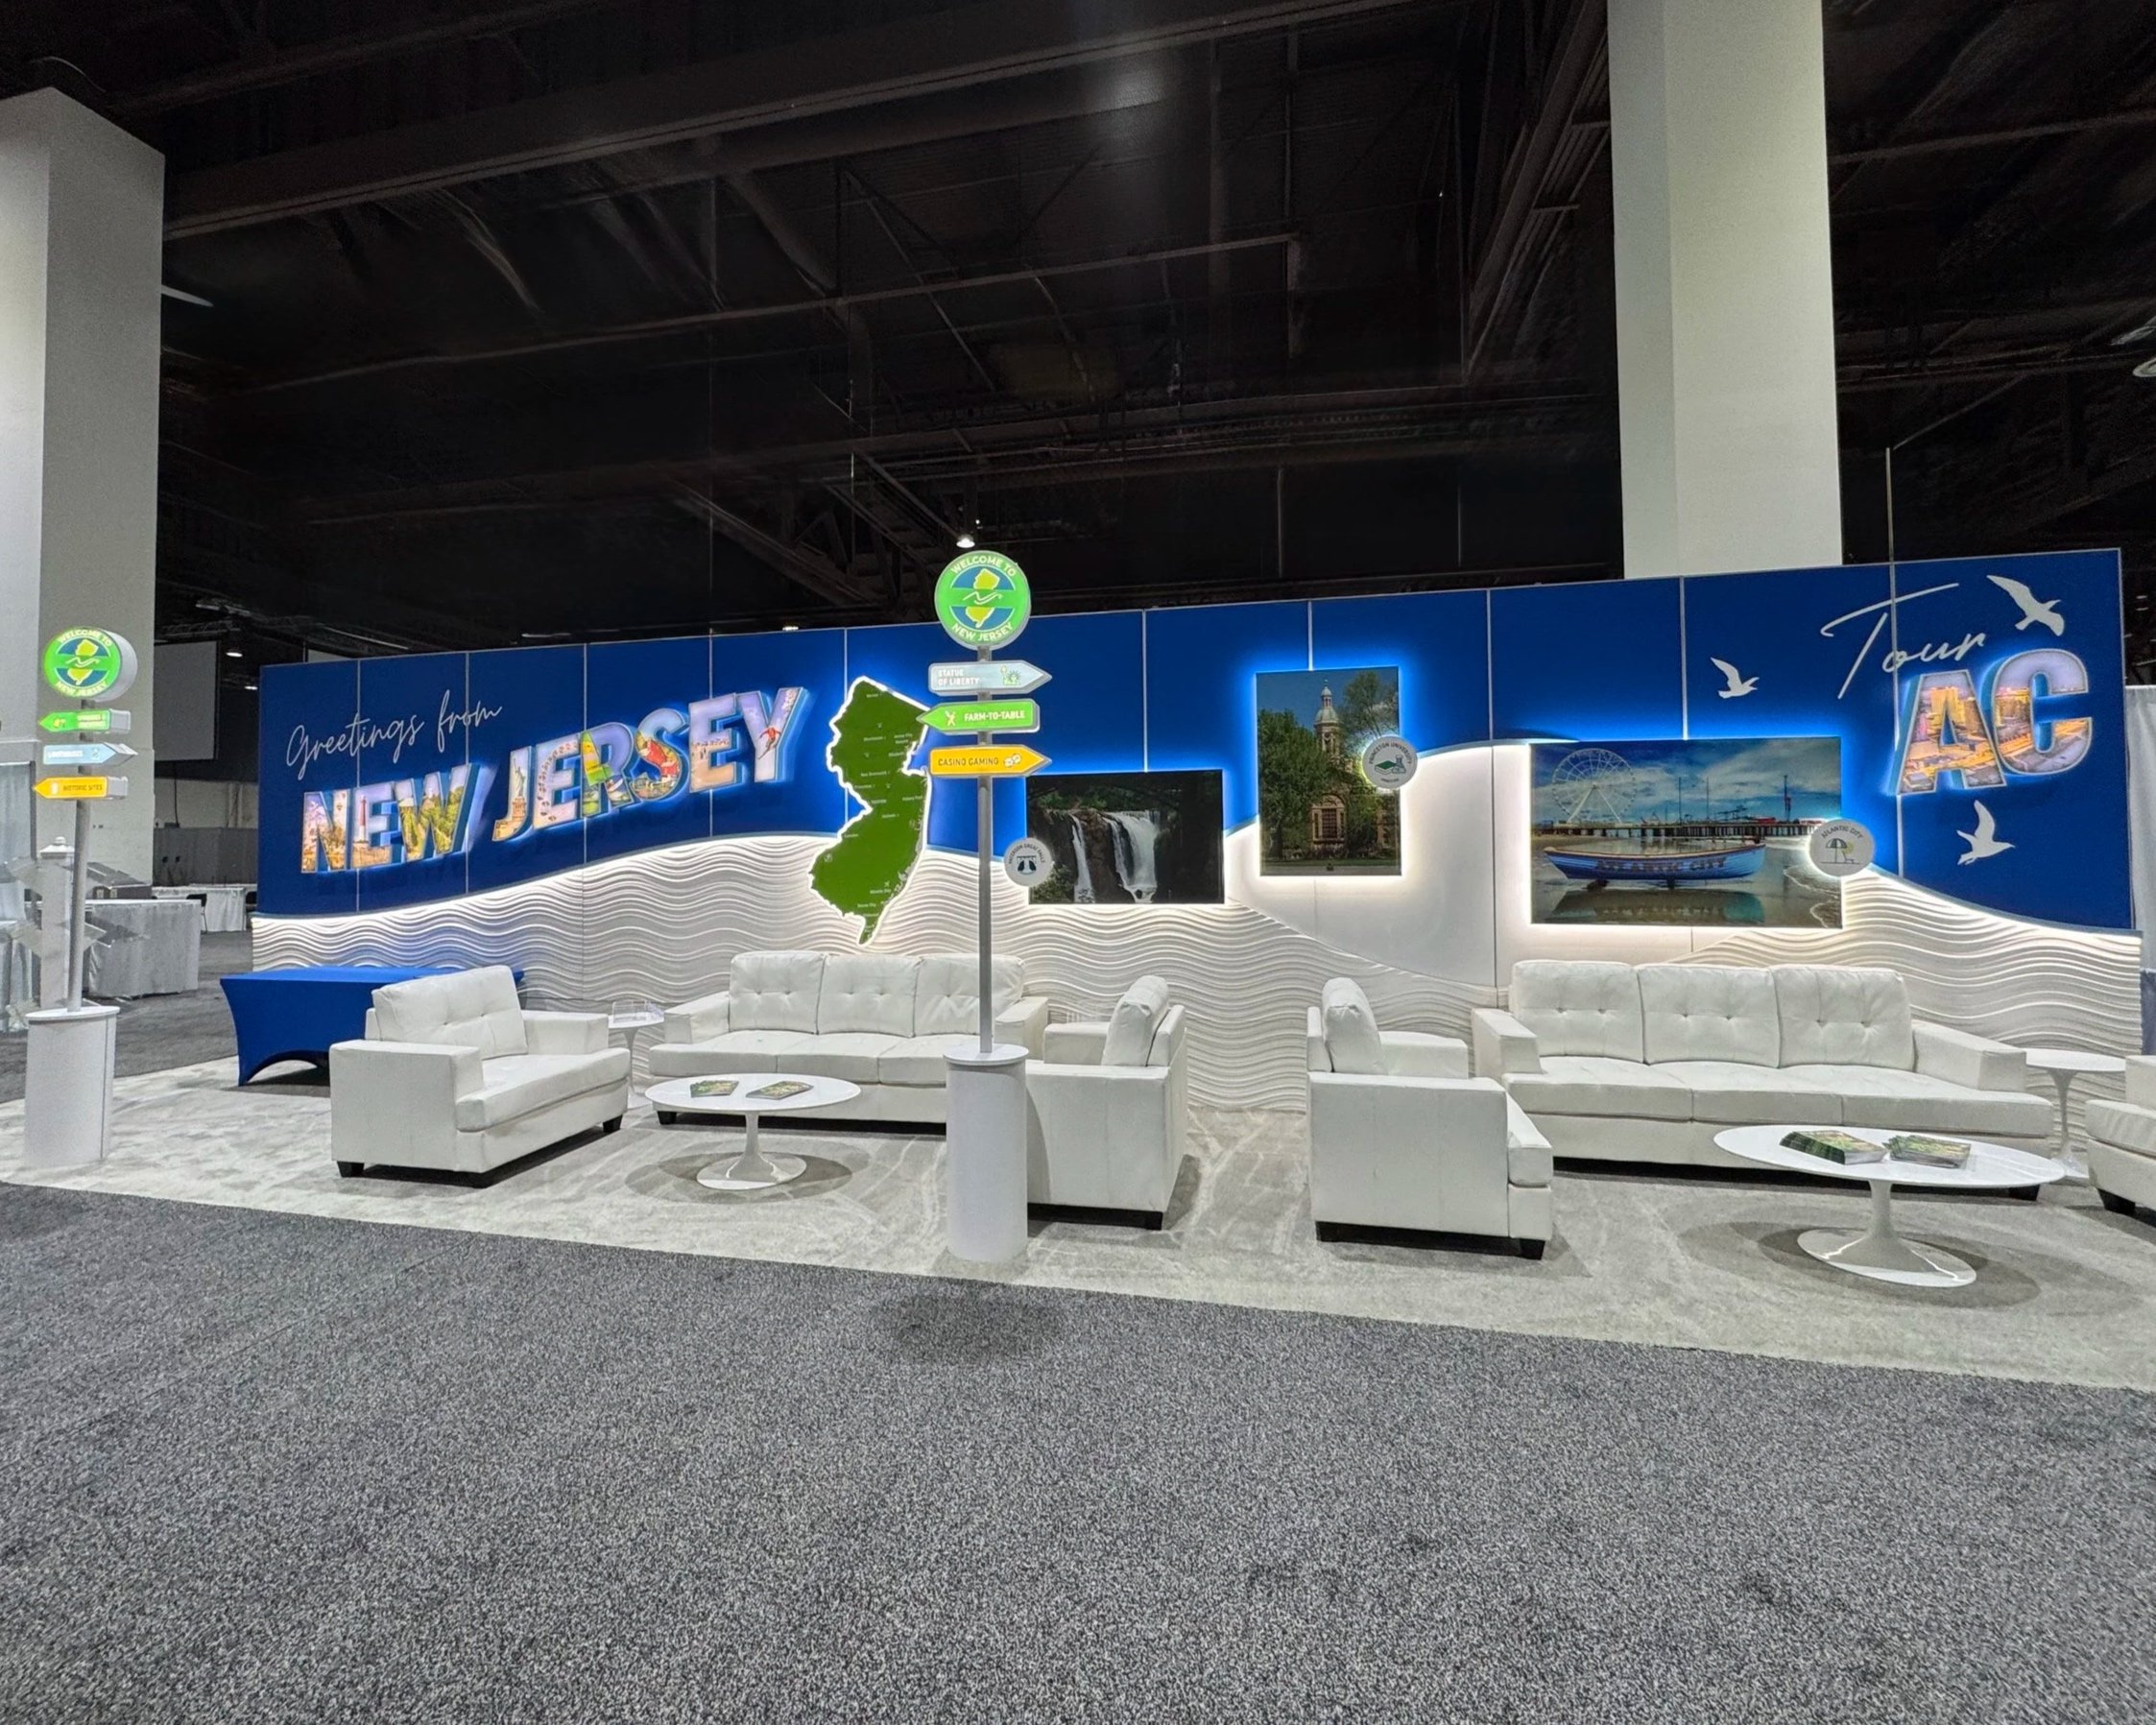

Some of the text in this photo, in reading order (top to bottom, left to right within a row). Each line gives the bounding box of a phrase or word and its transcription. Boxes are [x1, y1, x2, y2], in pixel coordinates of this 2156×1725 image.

[950, 555, 1017, 577] WELCOME TO
[58, 629, 112, 647] WELCOME TO
[952, 621, 1014, 641] NEW JERSEY
[1820, 583, 1986, 699] Tour
[56, 680, 77, 696] NEW
[949, 677, 979, 685] LIBERTY
[964, 710, 1025, 722] FARM-TO-TABLE
[1895, 648, 2093, 796] AC
[286, 689, 502, 780] Greetings from
[938, 756, 999, 767] CASINO GAMING
[301, 686, 805, 874] NEW JERSEY
[1821, 826, 1863, 839] ATLANTIC CITY
